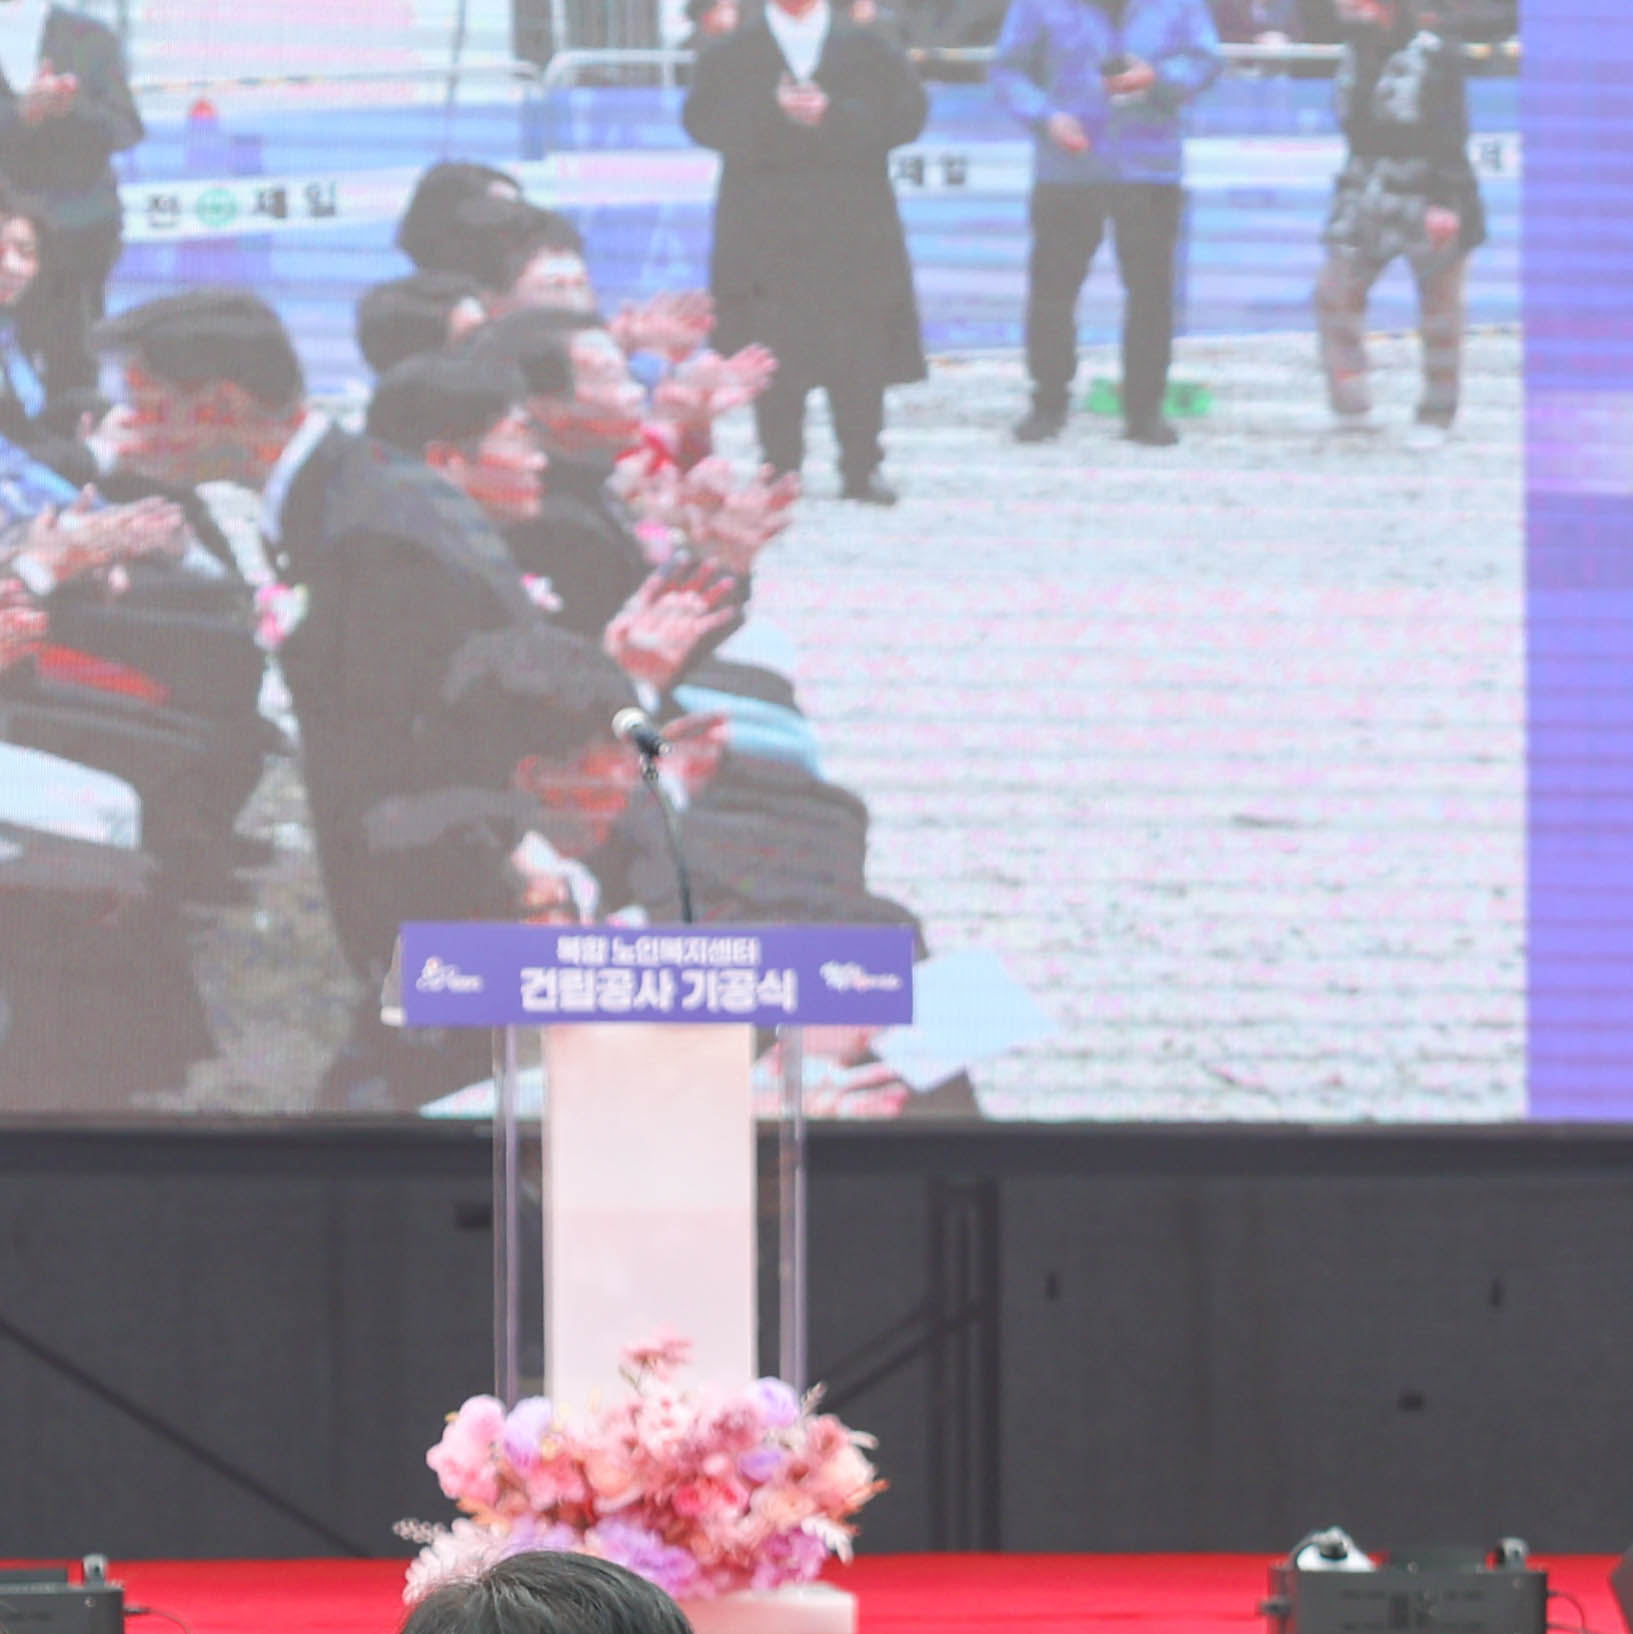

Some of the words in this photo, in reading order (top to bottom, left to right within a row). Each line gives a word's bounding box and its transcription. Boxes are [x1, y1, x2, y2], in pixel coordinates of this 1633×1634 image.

[557, 934, 610, 965] 복합
[612, 935, 761, 967] 노인복지센터
[520, 967, 677, 1013] 건립공사
[681, 967, 799, 1014] 기공식
